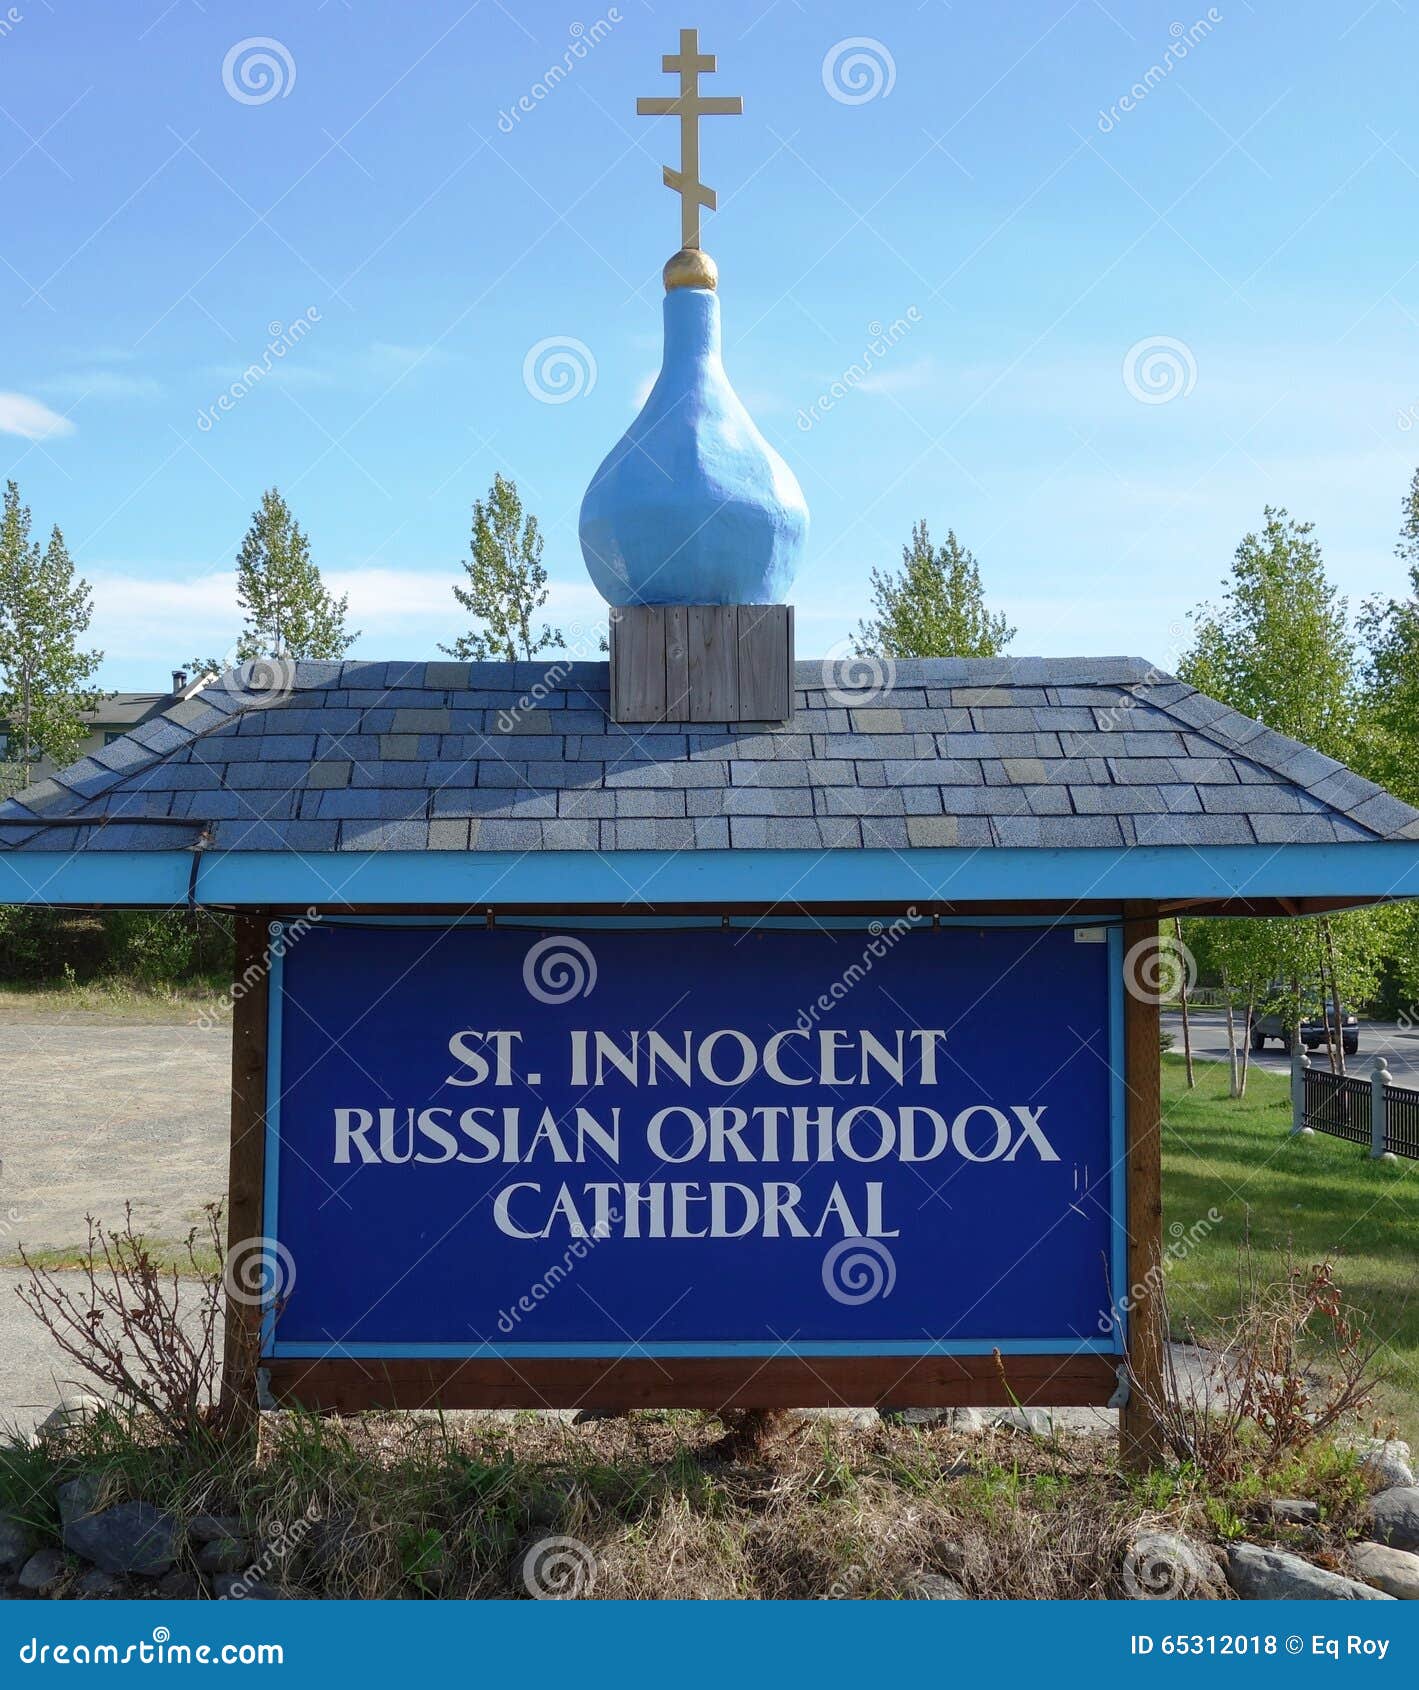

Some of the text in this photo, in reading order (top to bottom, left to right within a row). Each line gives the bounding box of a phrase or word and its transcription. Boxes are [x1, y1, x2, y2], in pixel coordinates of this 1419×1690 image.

[446, 1030, 945, 1086] ST. INNOCENT
[335, 1106, 1060, 1163] RUSSIAN ORTHODOX
[494, 1182, 899, 1238] CATHEDRAL
